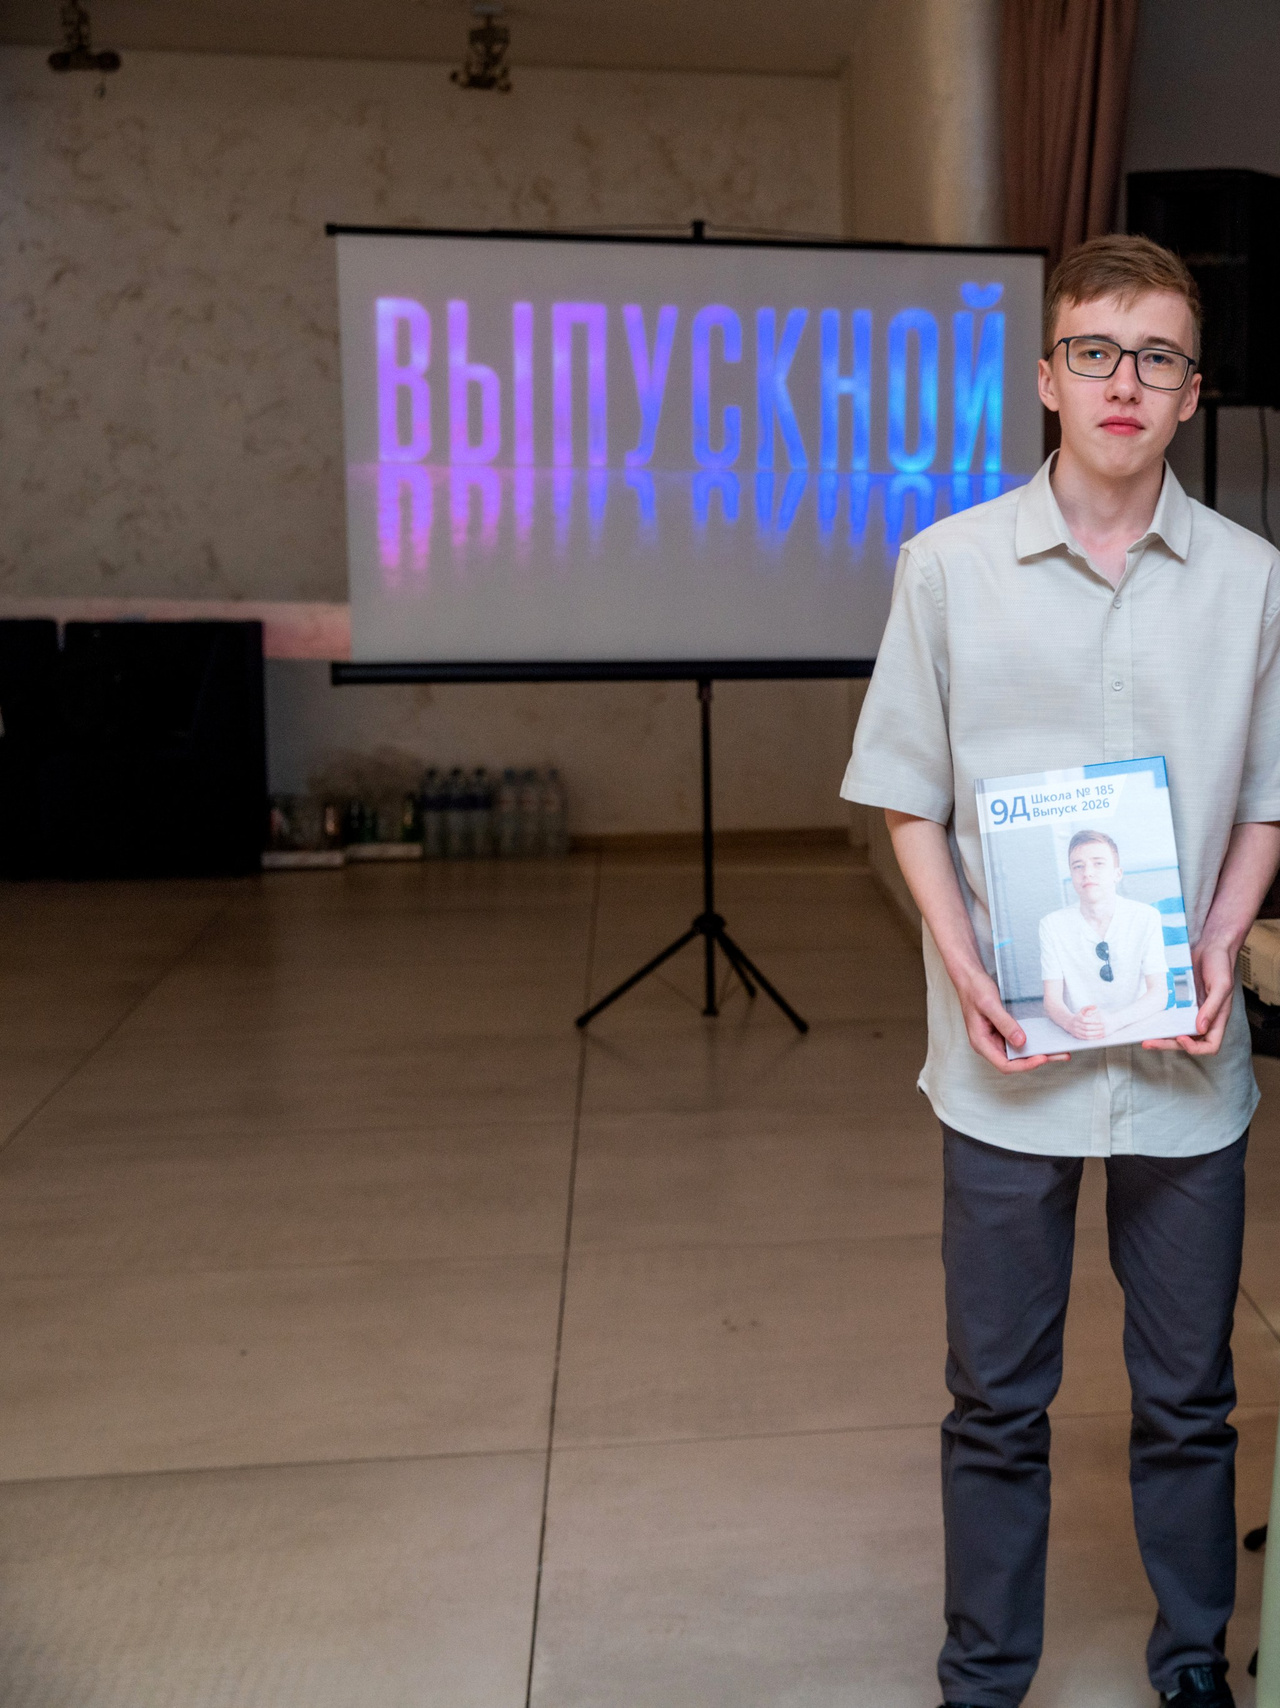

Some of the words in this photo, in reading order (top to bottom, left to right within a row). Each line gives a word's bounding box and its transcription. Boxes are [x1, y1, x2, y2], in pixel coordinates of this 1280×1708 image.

[376, 282, 1006, 473] ВЫПУСКНОЙ
[1031, 792, 1072, 805] Школа
[1076, 787, 1091, 798] №
[1095, 784, 1115, 796] 185
[990, 796, 1031, 825] 9Д
[1032, 804, 1078, 818] Выпуск
[1081, 798, 1110, 811] 2026
